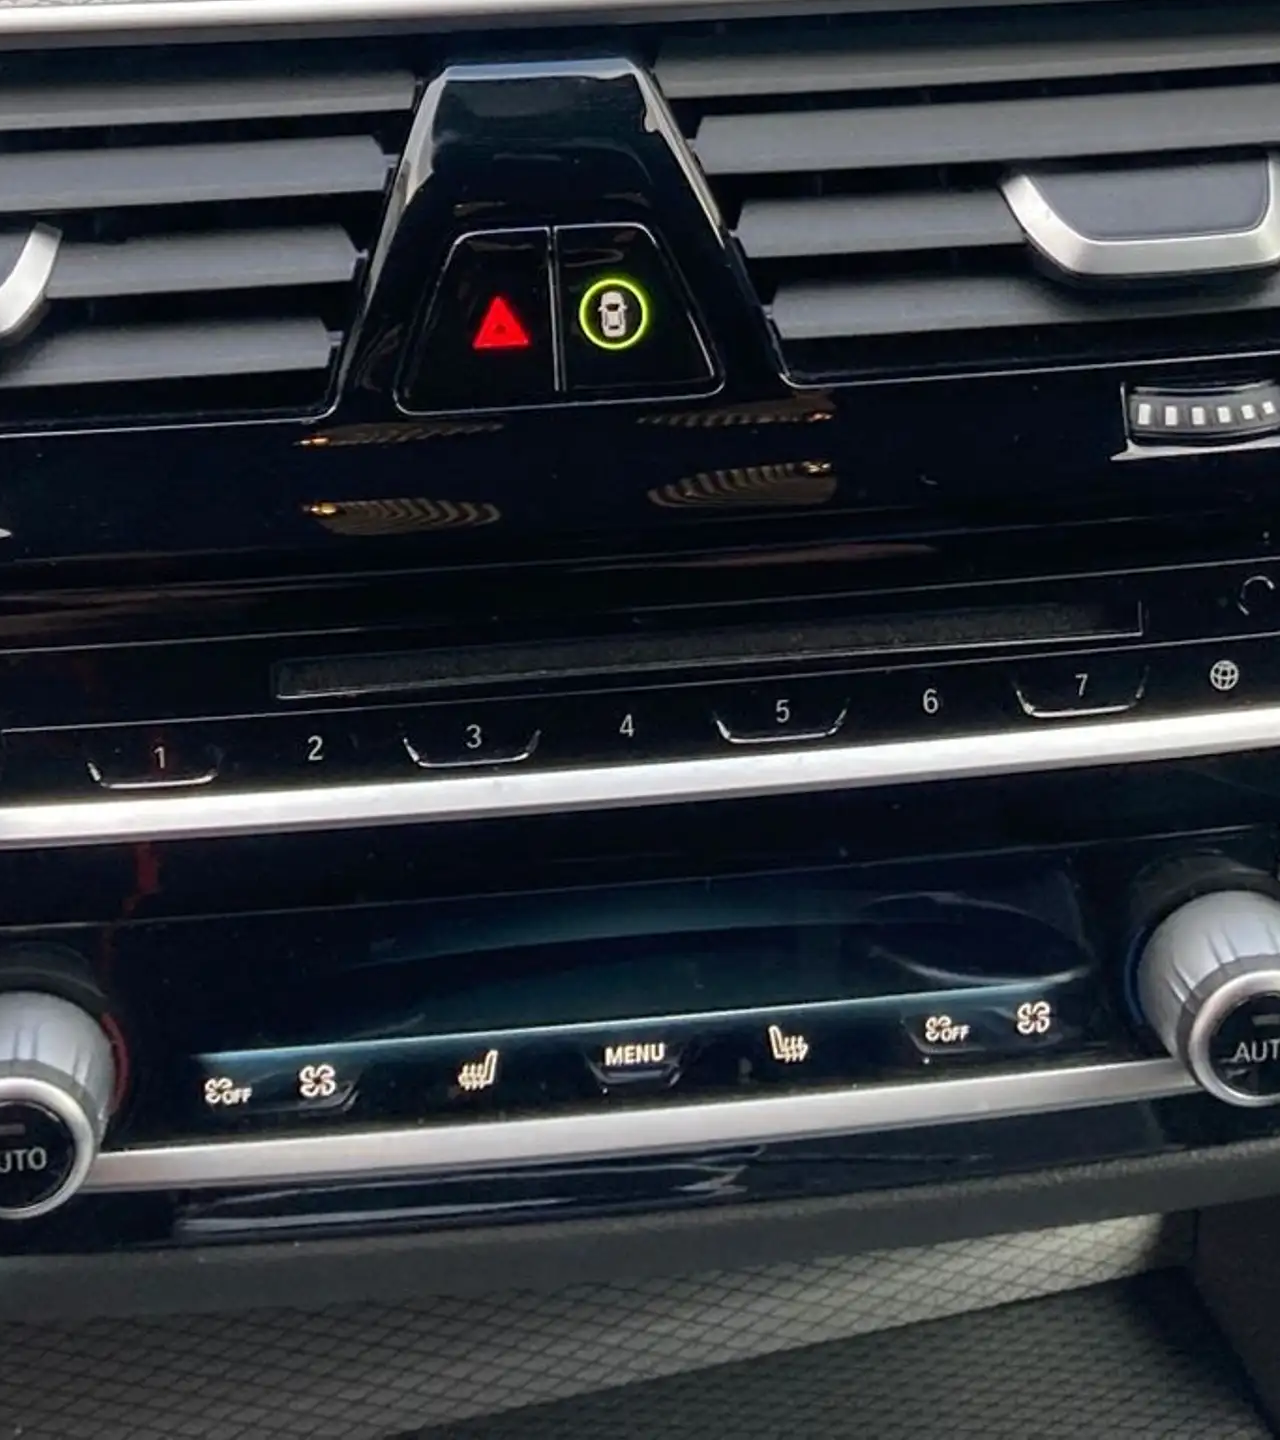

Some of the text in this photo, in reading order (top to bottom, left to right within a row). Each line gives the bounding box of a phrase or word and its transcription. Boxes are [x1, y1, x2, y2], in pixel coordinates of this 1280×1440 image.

[154, 673, 1089, 768] 1 2 3 4 5 6 7
[223, 1025, 969, 1105] OFF MENU OFF
